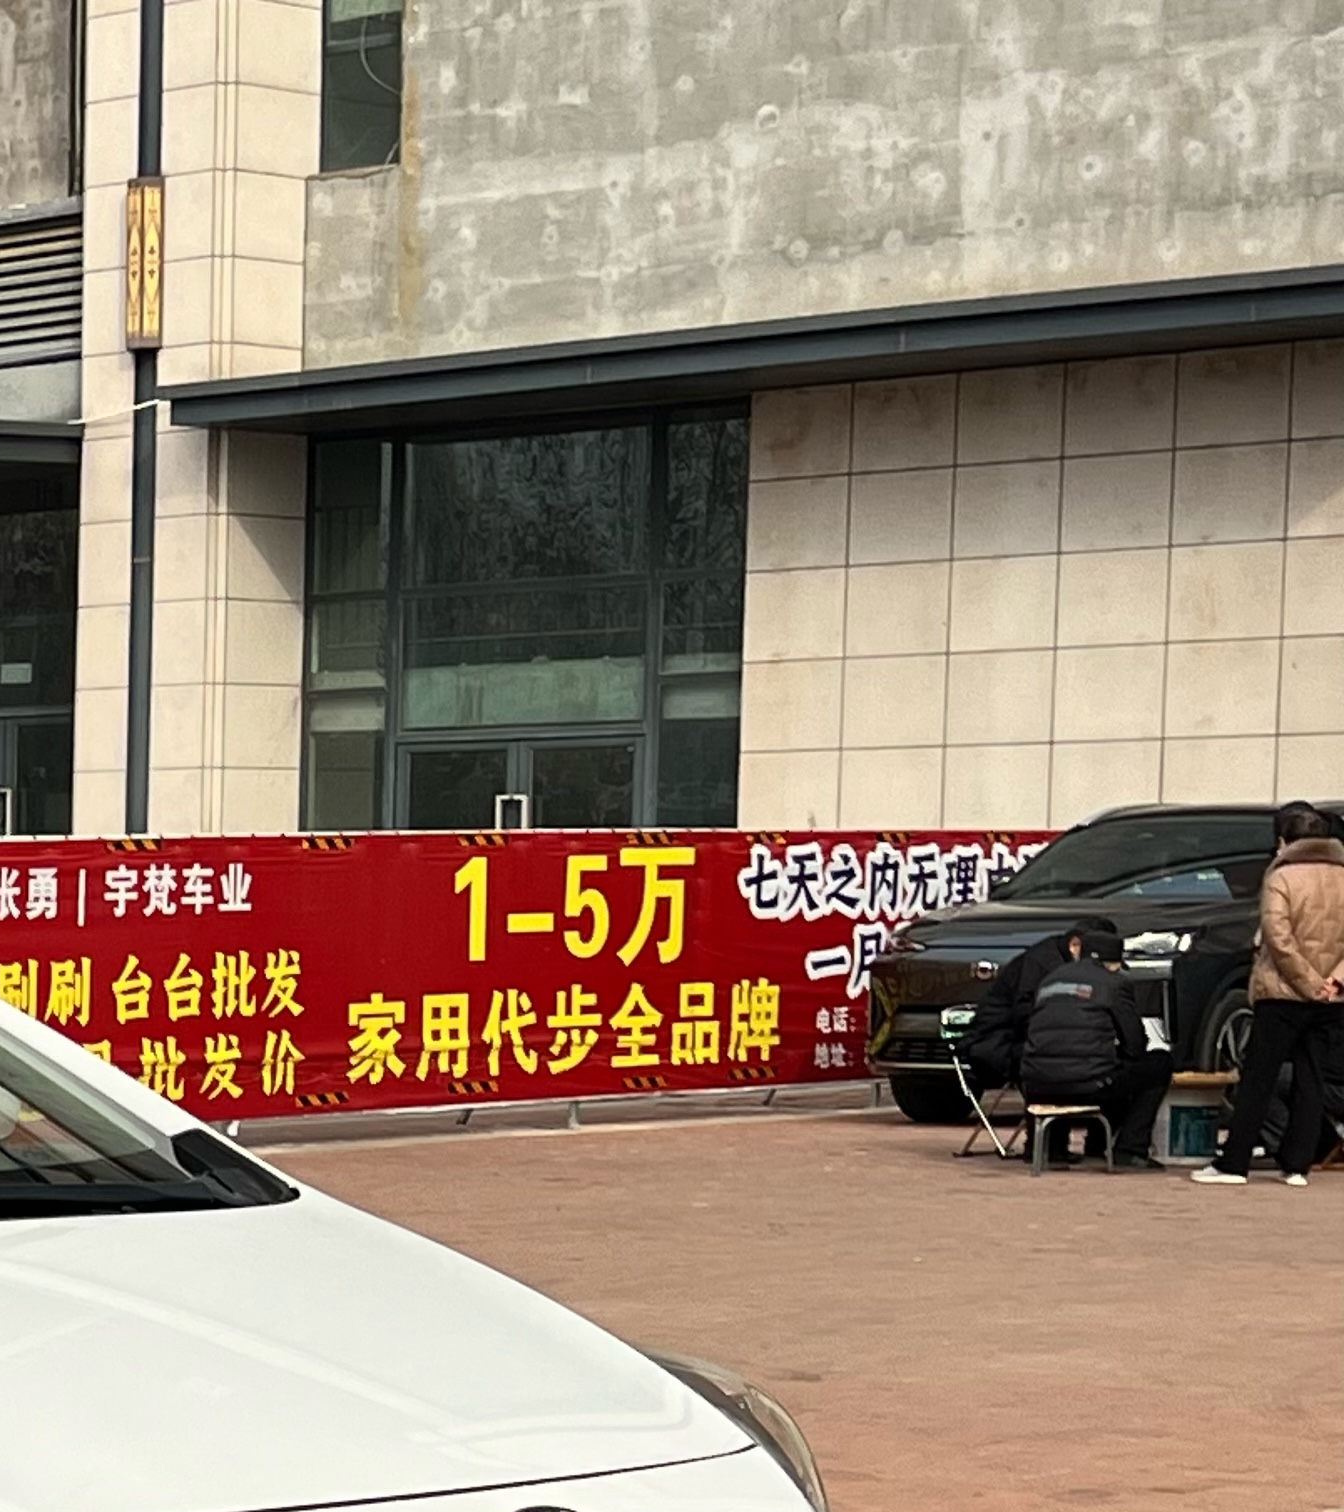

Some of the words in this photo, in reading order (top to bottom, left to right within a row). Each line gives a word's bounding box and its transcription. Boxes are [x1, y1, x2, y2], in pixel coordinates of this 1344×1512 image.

[104, 862, 252, 918] 宇梵车业
[345, 976, 781, 1085] 家用代步全品牌
